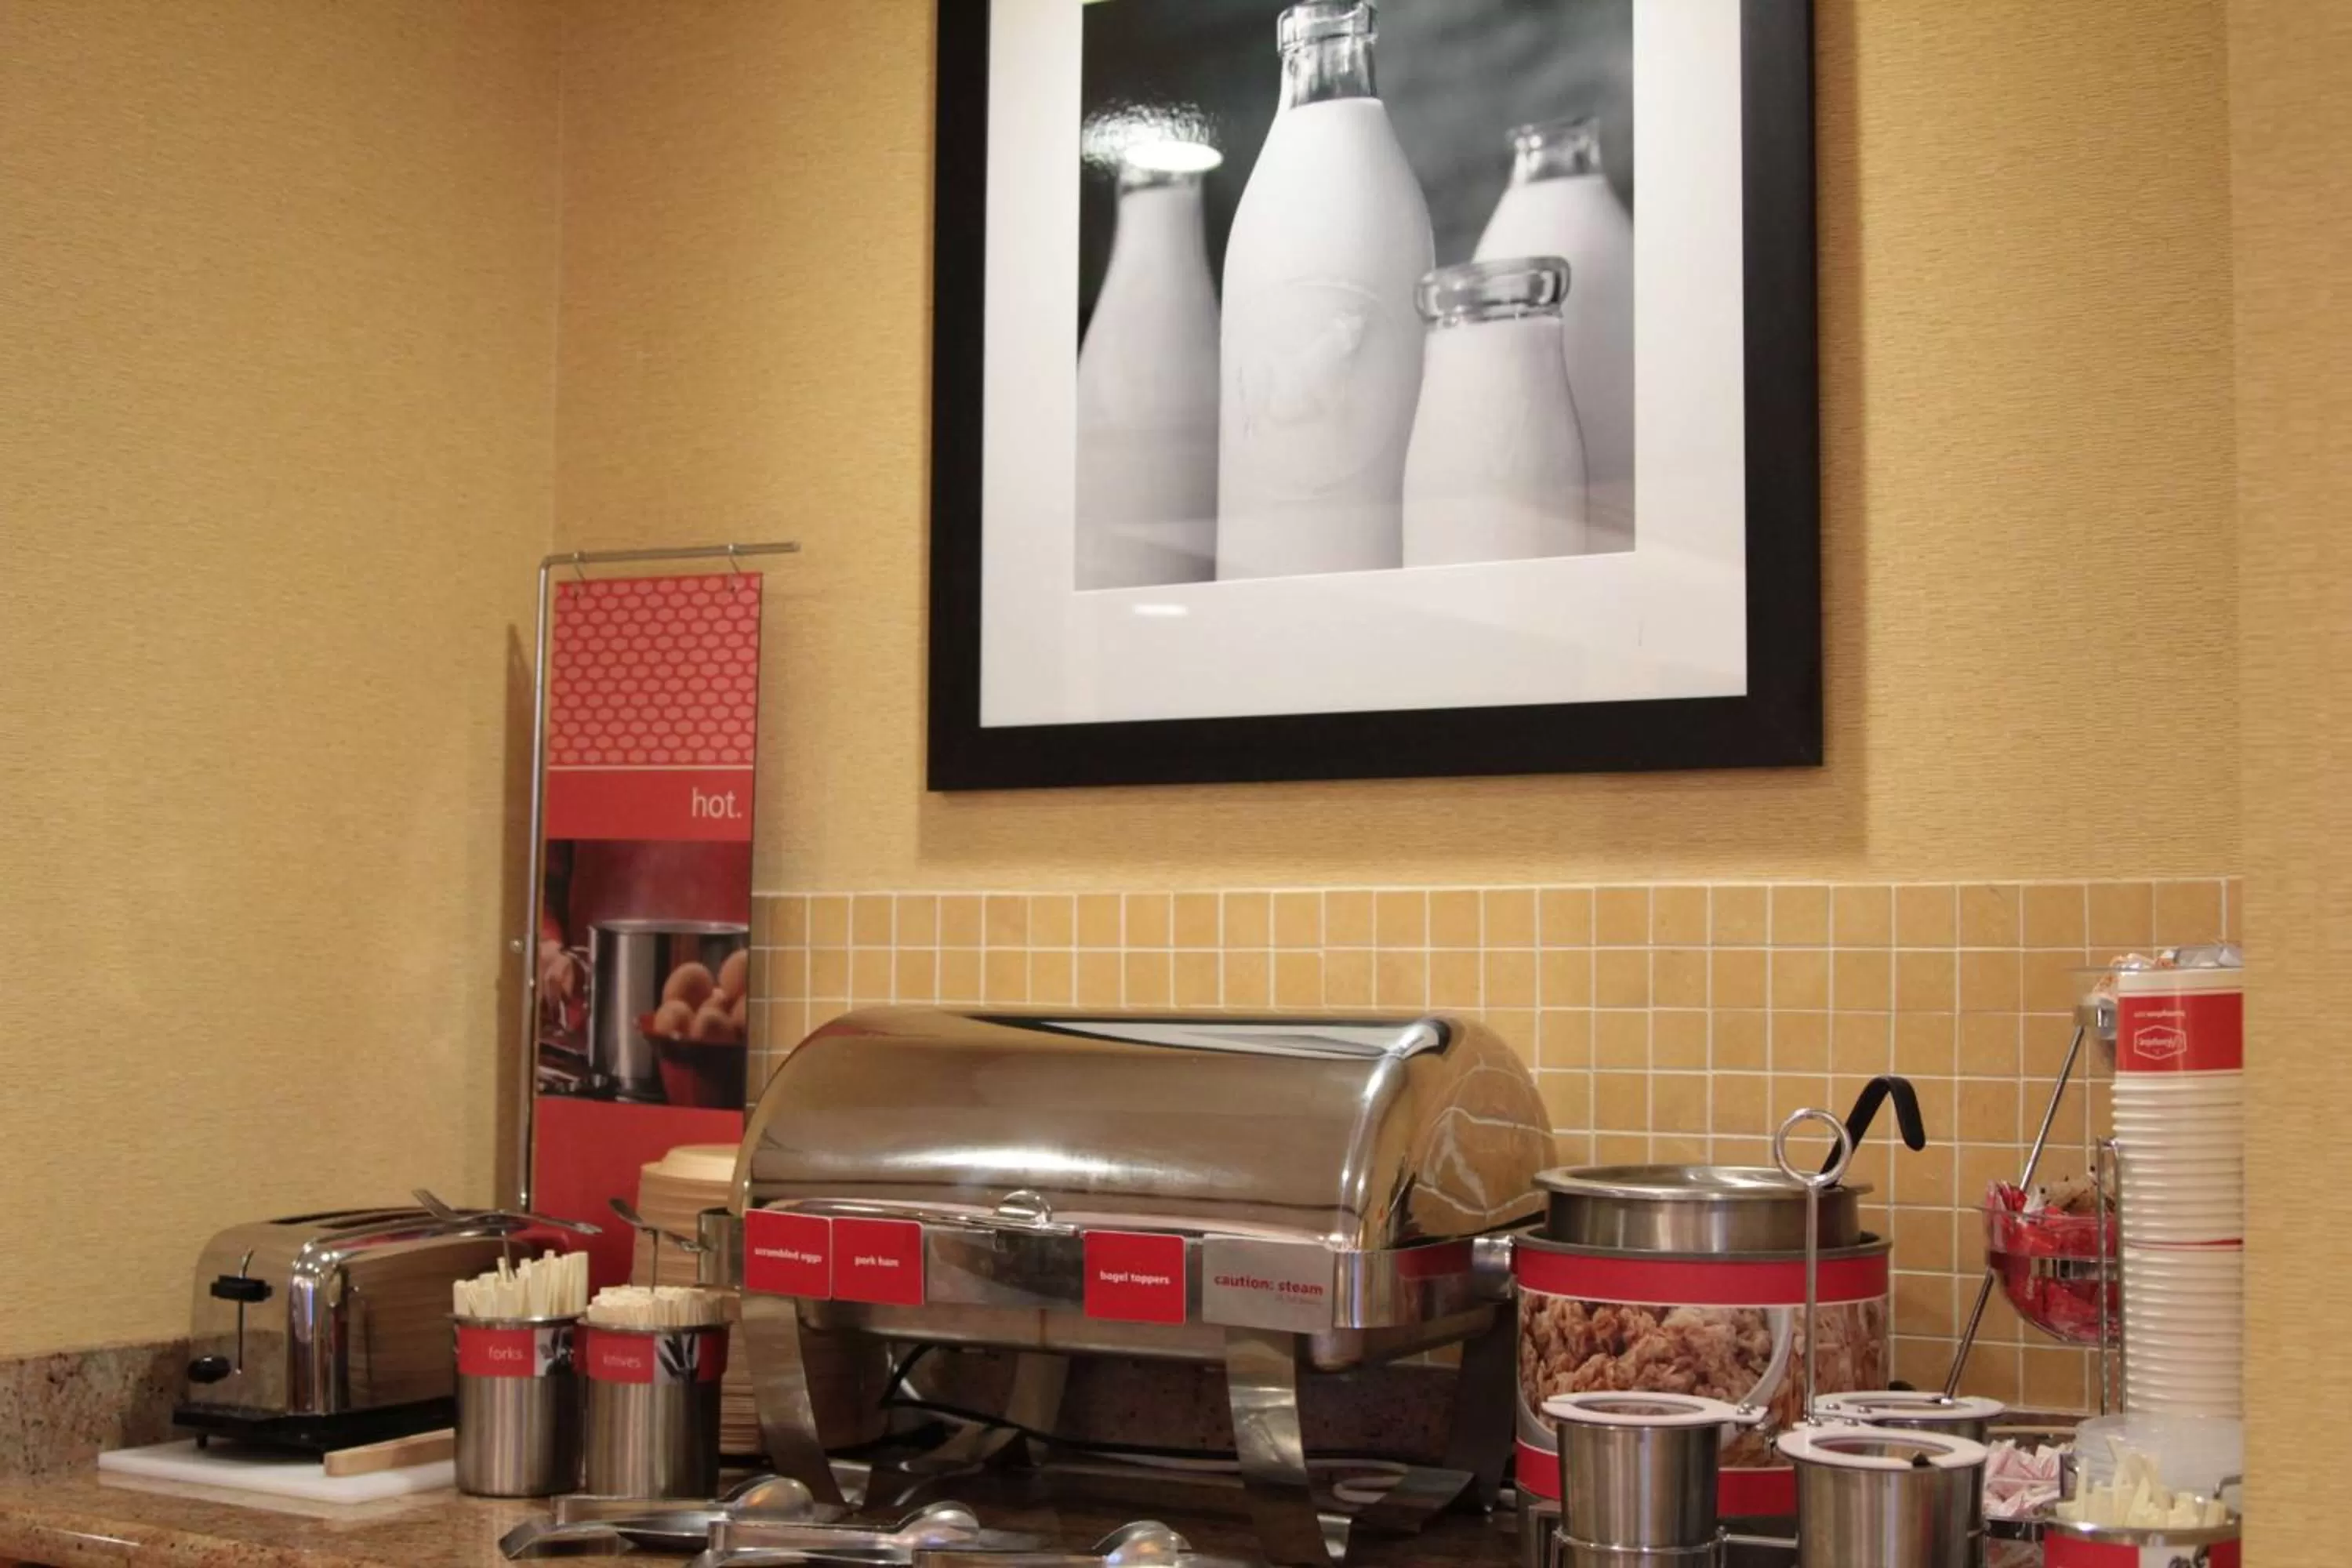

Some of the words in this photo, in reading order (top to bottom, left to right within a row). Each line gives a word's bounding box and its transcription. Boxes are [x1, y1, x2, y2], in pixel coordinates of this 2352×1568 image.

[691, 786, 743, 819] hot.
[800, 1253, 822, 1264] eggs
[855, 1255, 876, 1266] pork
[878, 1256, 899, 1268] ham
[1099, 1270, 1128, 1283] bagel
[1130, 1272, 1171, 1286] toppers
[1214, 1274, 1275, 1291] caution:
[1277, 1279, 1324, 1297] steam
[488, 1345, 524, 1361] forks
